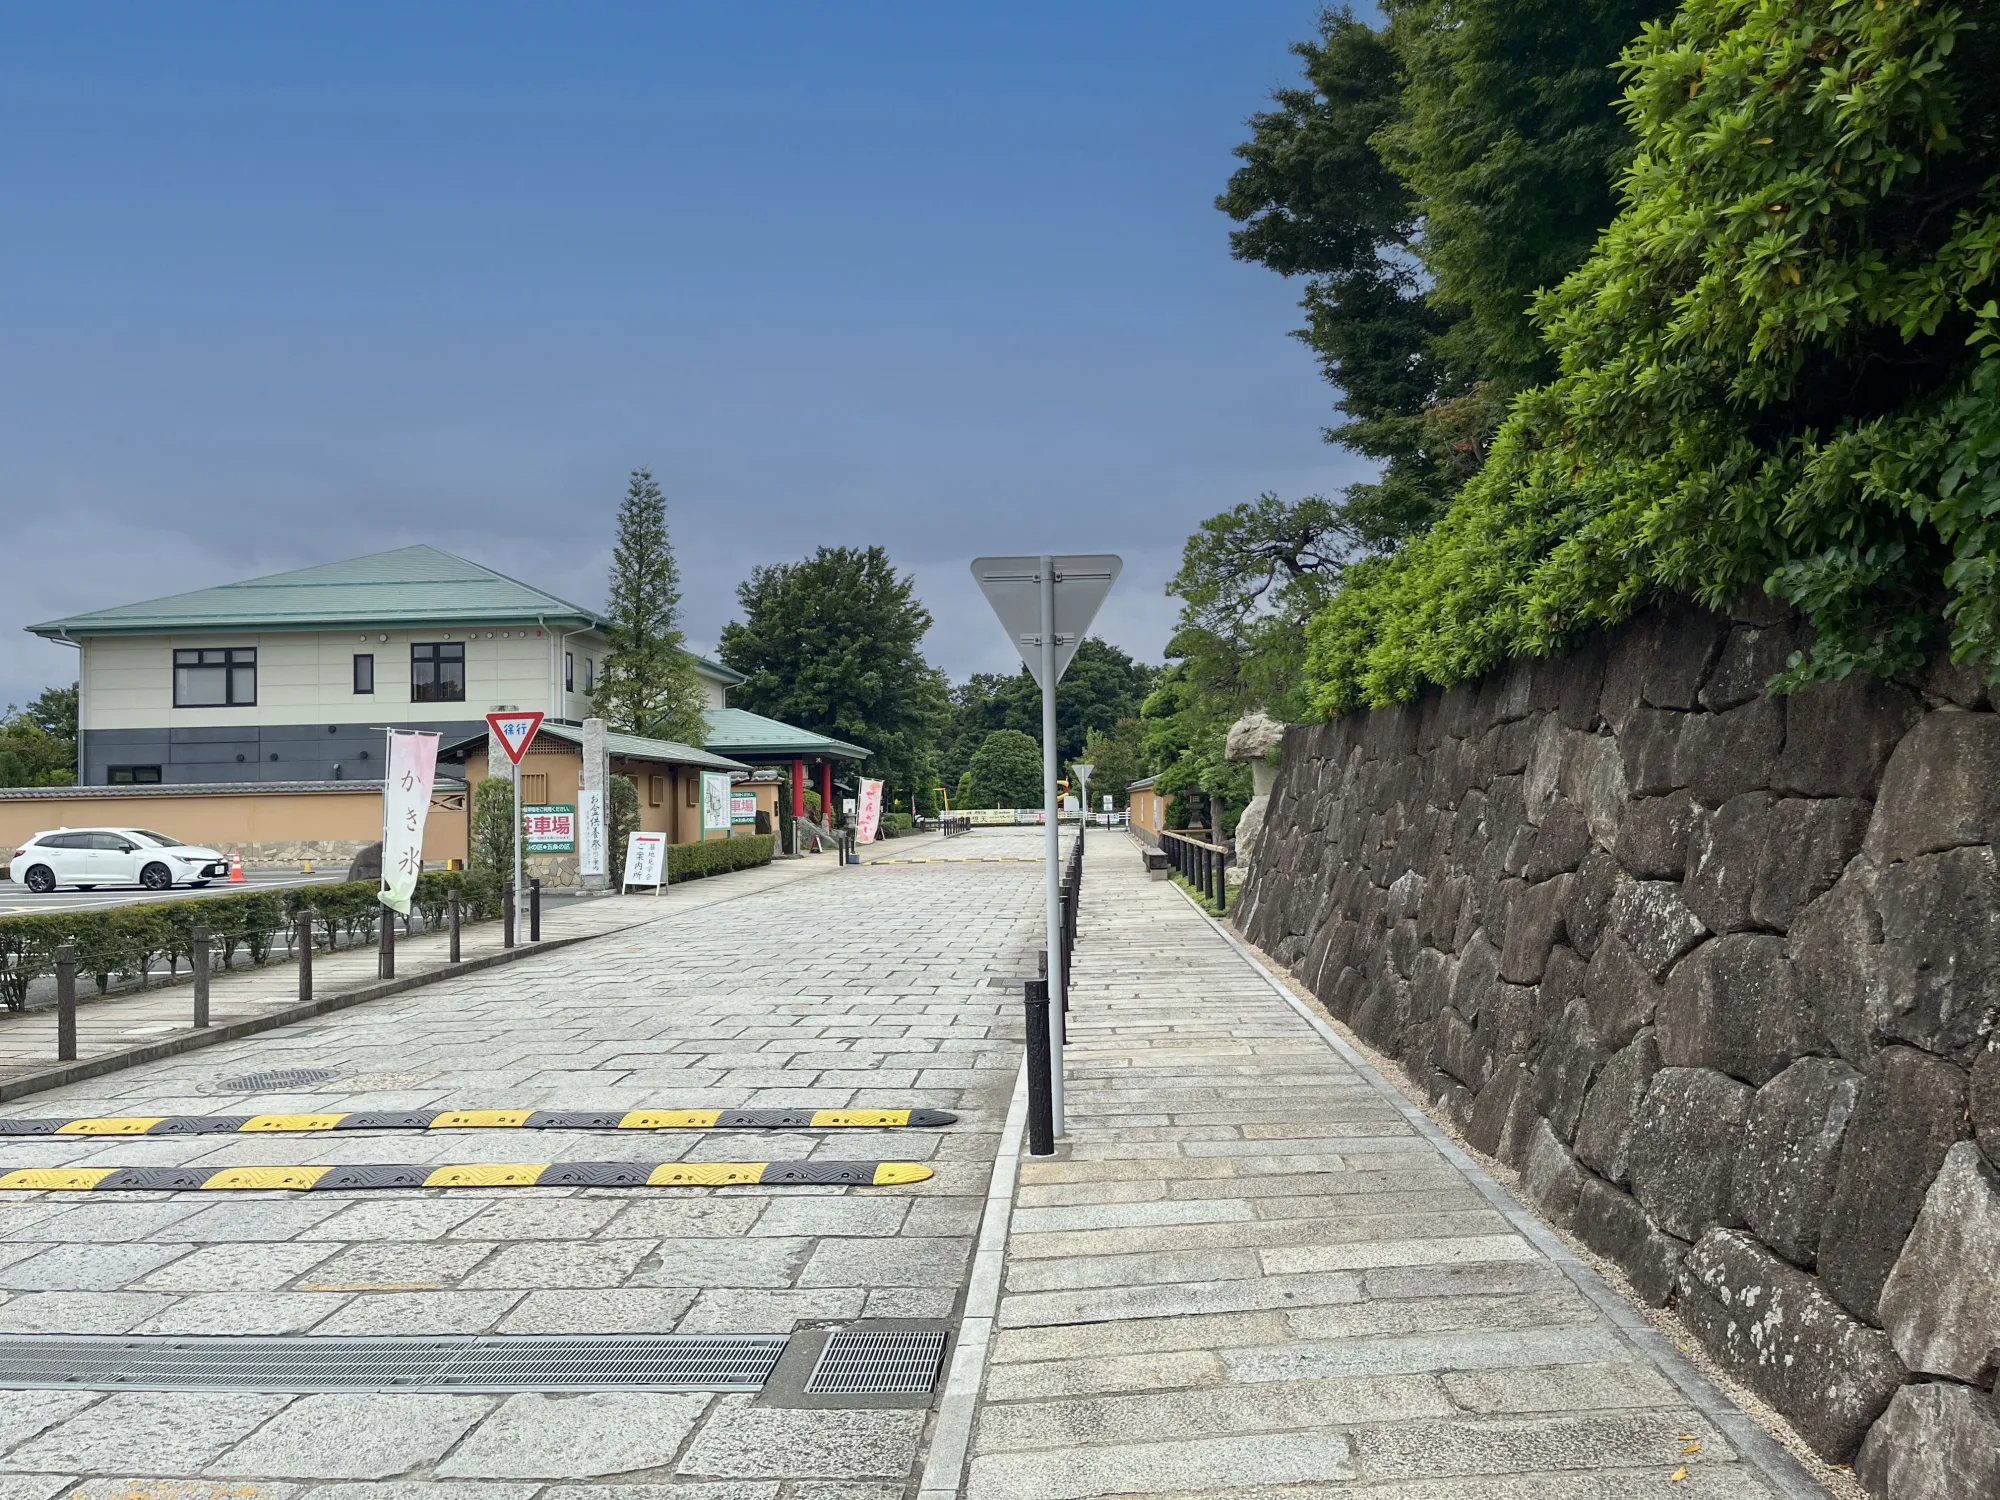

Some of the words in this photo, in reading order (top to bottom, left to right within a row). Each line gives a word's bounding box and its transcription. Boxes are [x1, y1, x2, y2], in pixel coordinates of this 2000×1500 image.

[503, 723, 527, 736] 徐行
[398, 770, 421, 876] かき氷
[632, 843, 646, 881] ご案内所
